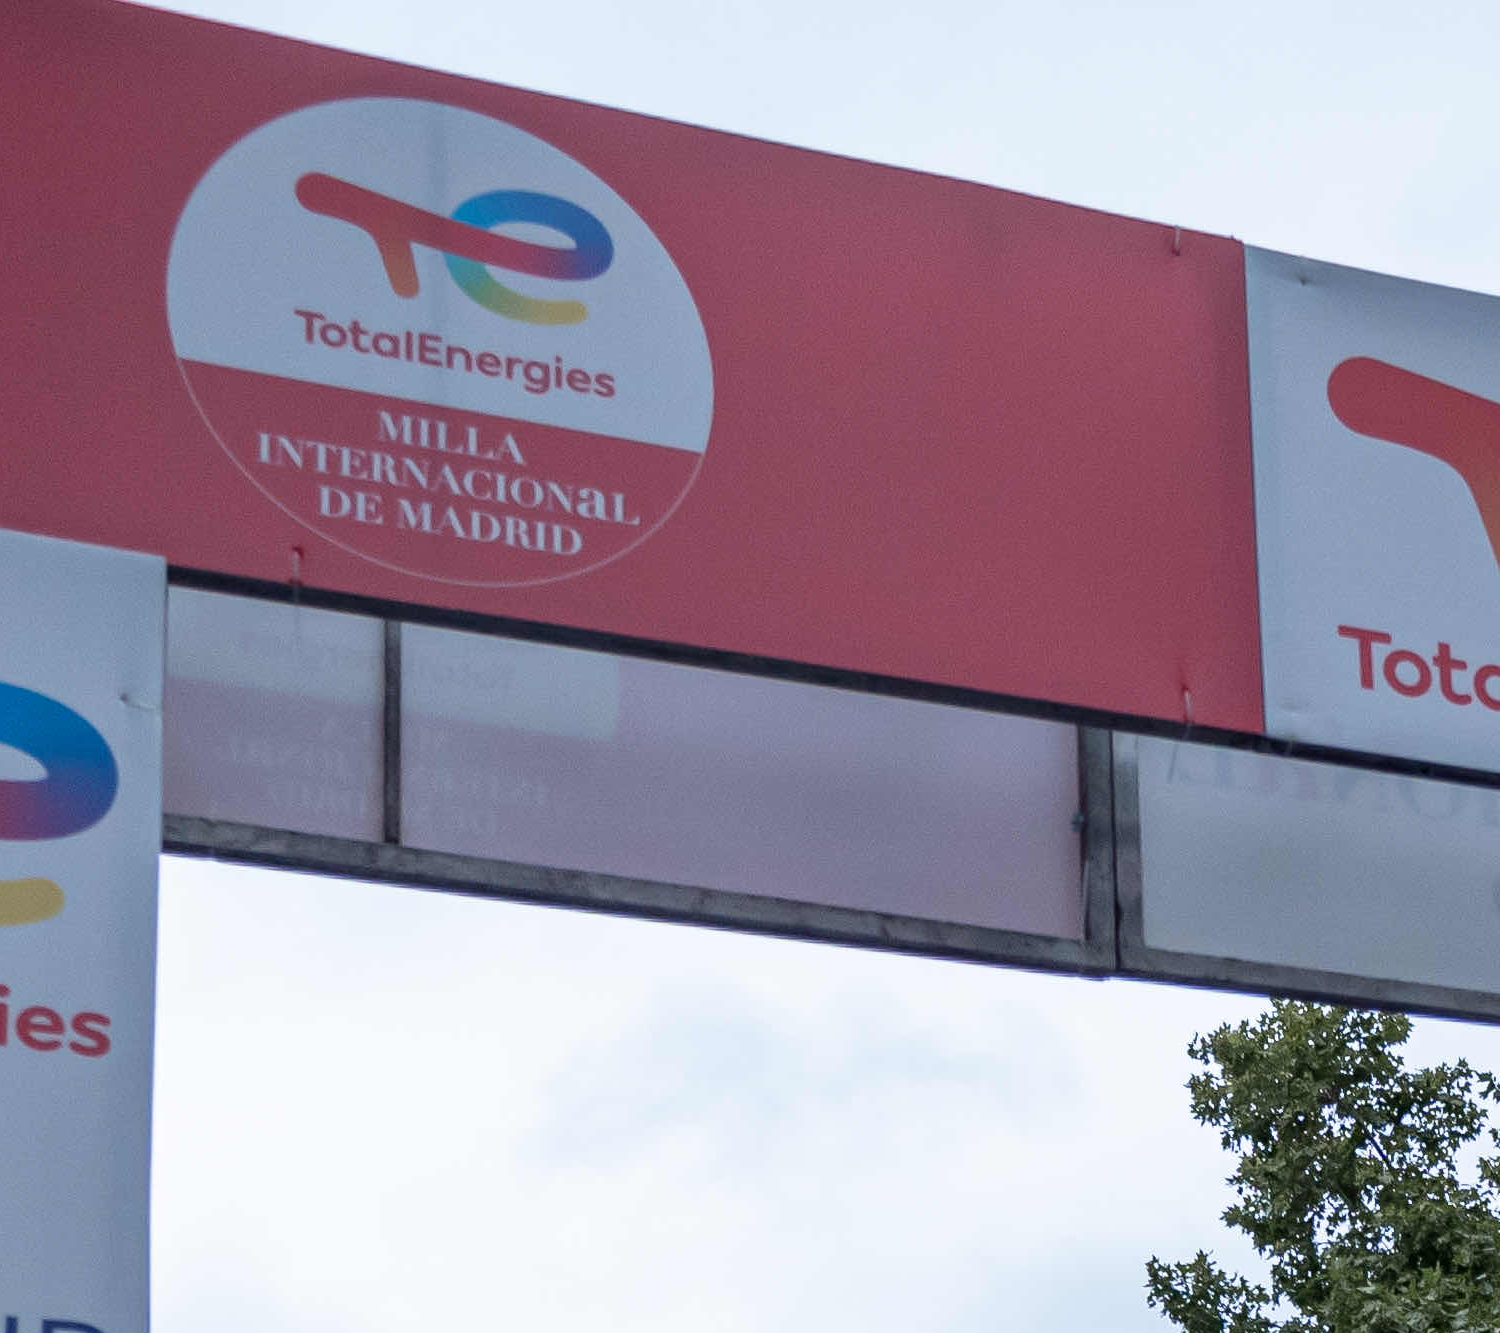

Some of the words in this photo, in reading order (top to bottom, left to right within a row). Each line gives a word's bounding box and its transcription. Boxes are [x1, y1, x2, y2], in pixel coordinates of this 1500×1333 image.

[294, 307, 616, 399] TotalEnergies
[377, 410, 526, 467] MILLA
[317, 484, 385, 526] DE
[398, 498, 583, 556] MADRID
